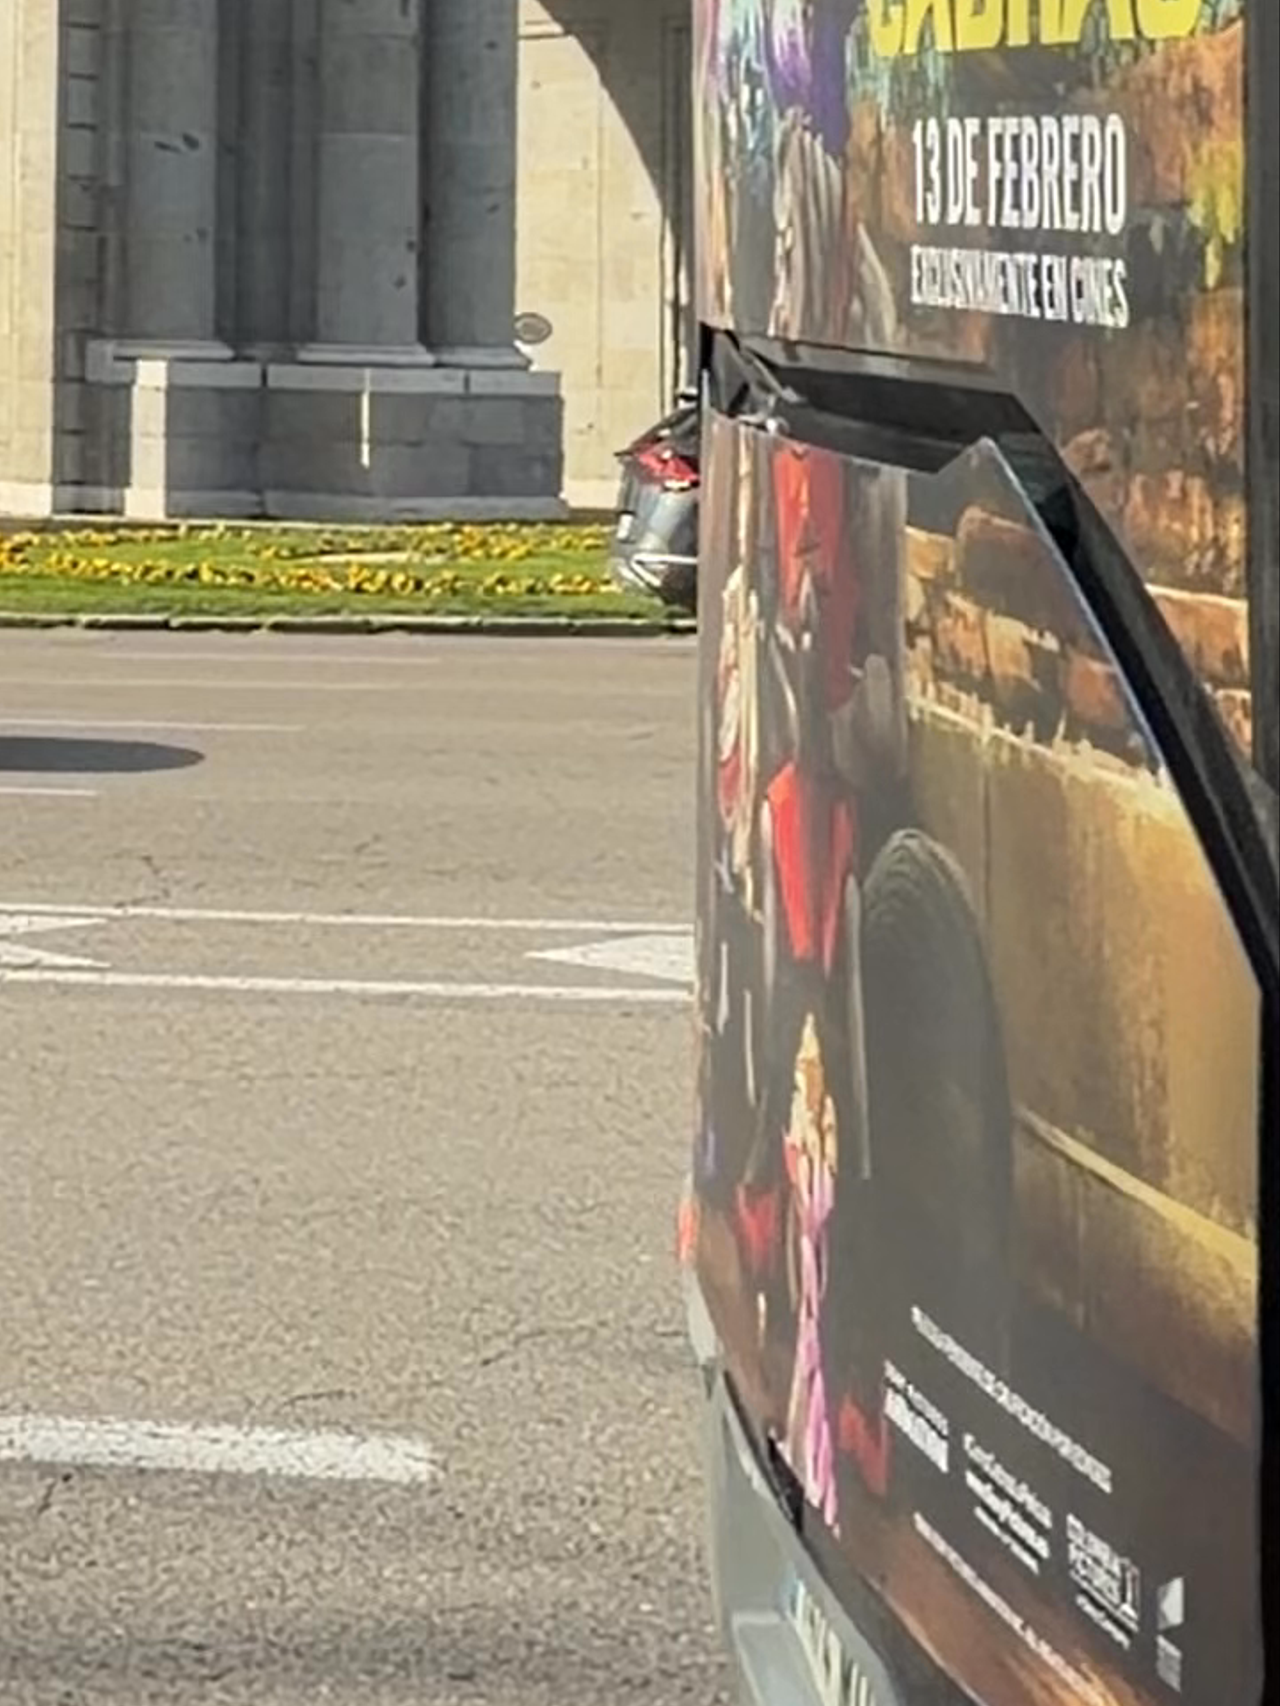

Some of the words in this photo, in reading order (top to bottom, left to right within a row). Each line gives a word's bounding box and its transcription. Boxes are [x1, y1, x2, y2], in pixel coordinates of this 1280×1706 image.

[913, 117, 940, 225] 13
[947, 117, 981, 226] DE
[988, 113, 1126, 235] FEBRERO
[1042, 254, 1068, 321] EN
[1071, 256, 1129, 328] CINES
